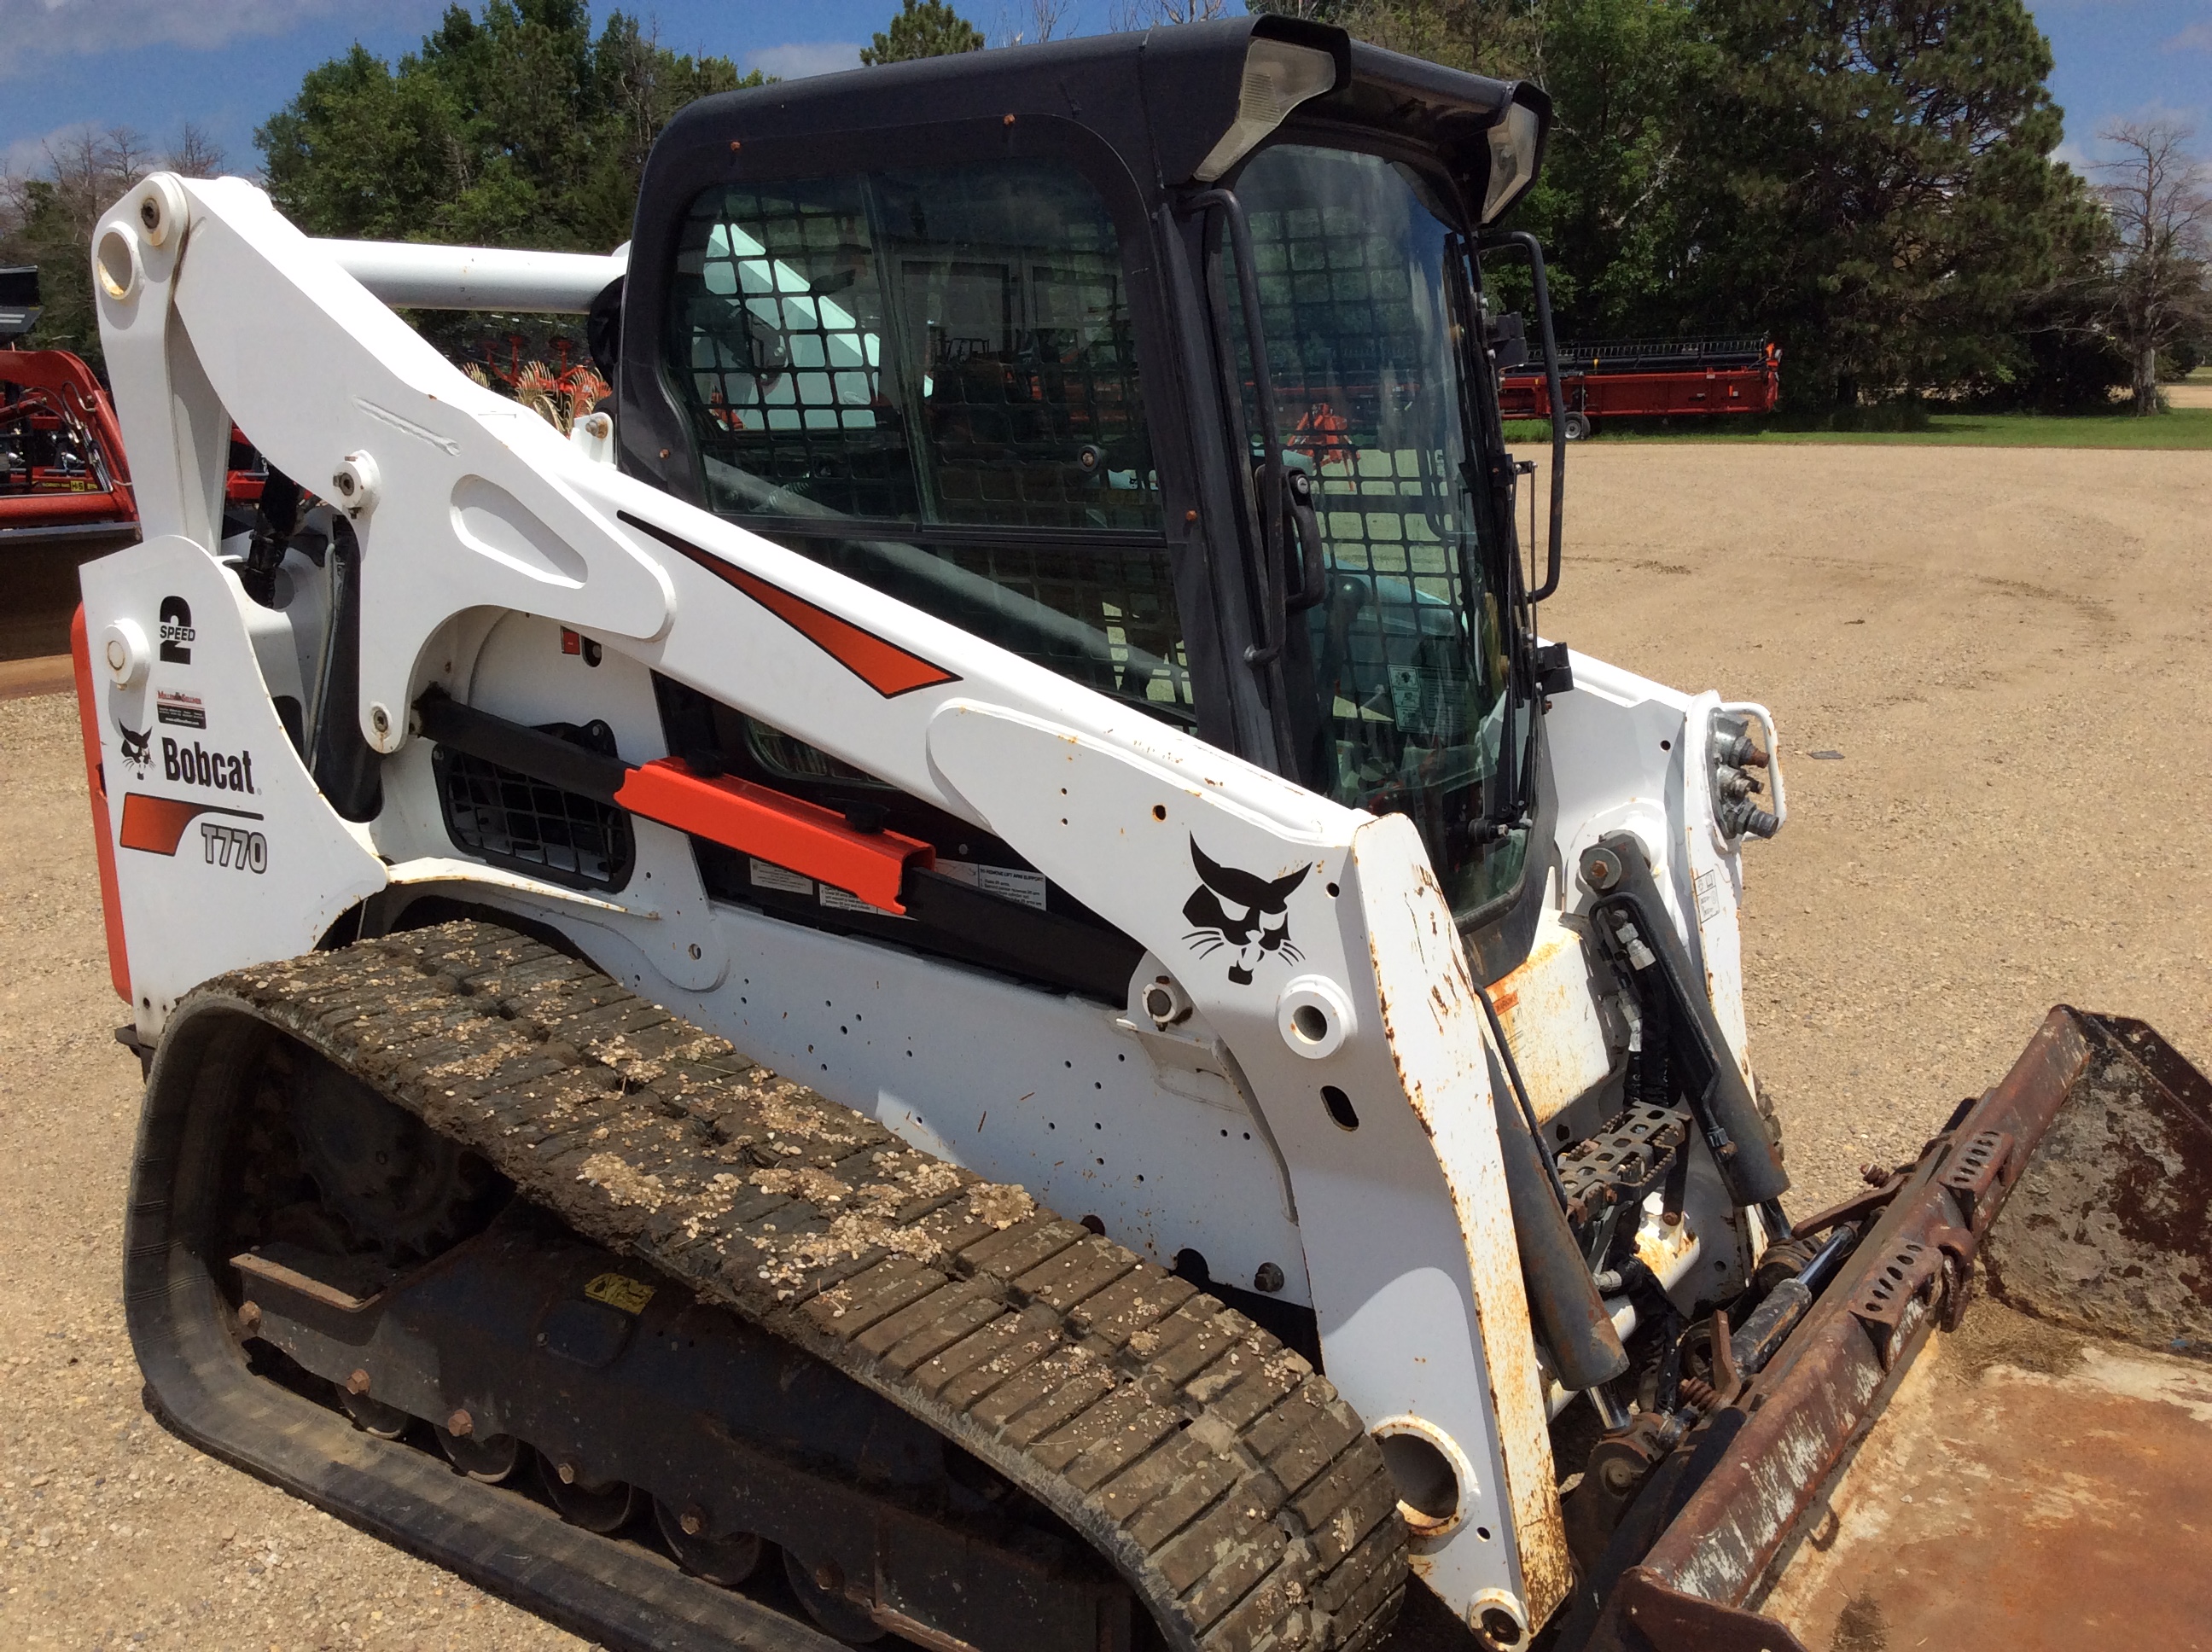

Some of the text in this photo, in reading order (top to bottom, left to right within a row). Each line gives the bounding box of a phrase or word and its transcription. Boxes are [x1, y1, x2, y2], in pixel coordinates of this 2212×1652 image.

[160, 596, 192, 665] 2
[160, 625, 195, 643] SPEED
[162, 737, 255, 794] Bobcat
[201, 823, 268, 874] T770
